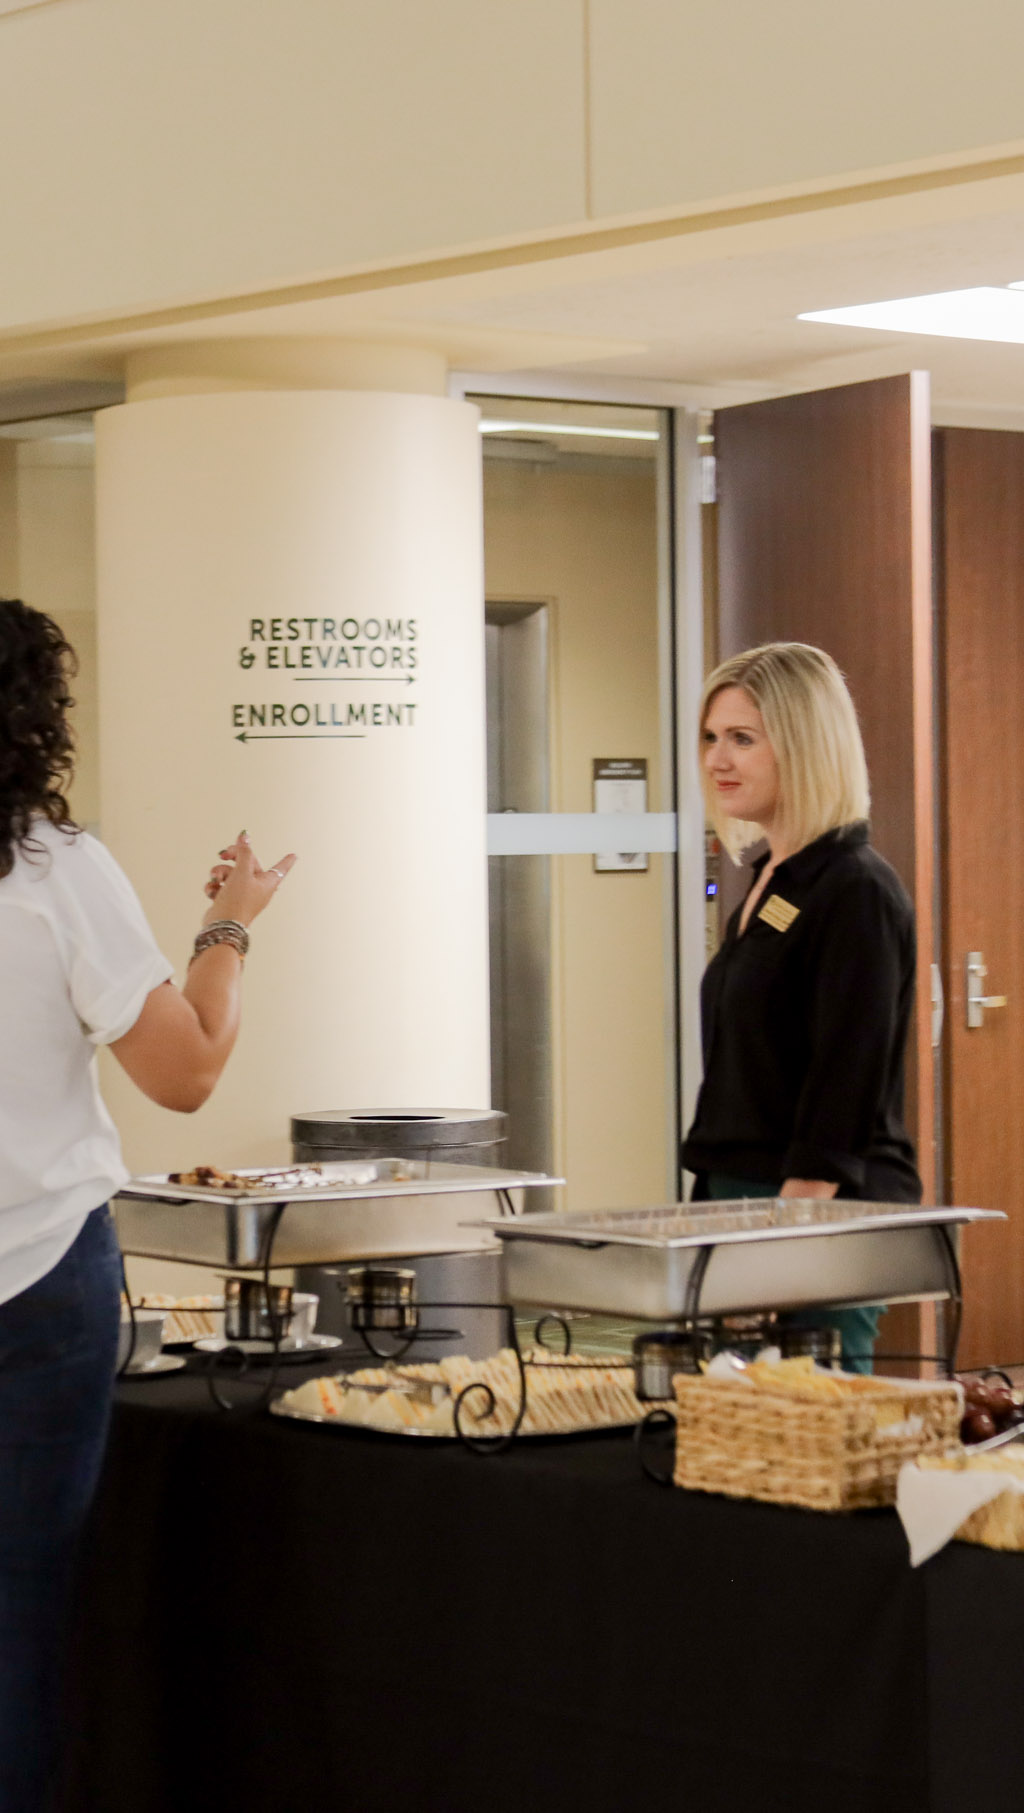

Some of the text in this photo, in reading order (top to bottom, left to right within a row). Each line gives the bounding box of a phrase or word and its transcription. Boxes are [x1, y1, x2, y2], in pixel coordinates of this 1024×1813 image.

[251, 618, 417, 641] RESTROOMS
[239, 646, 417, 669] & ELEVATORS
[232, 703, 417, 727] ENROLLMENT
